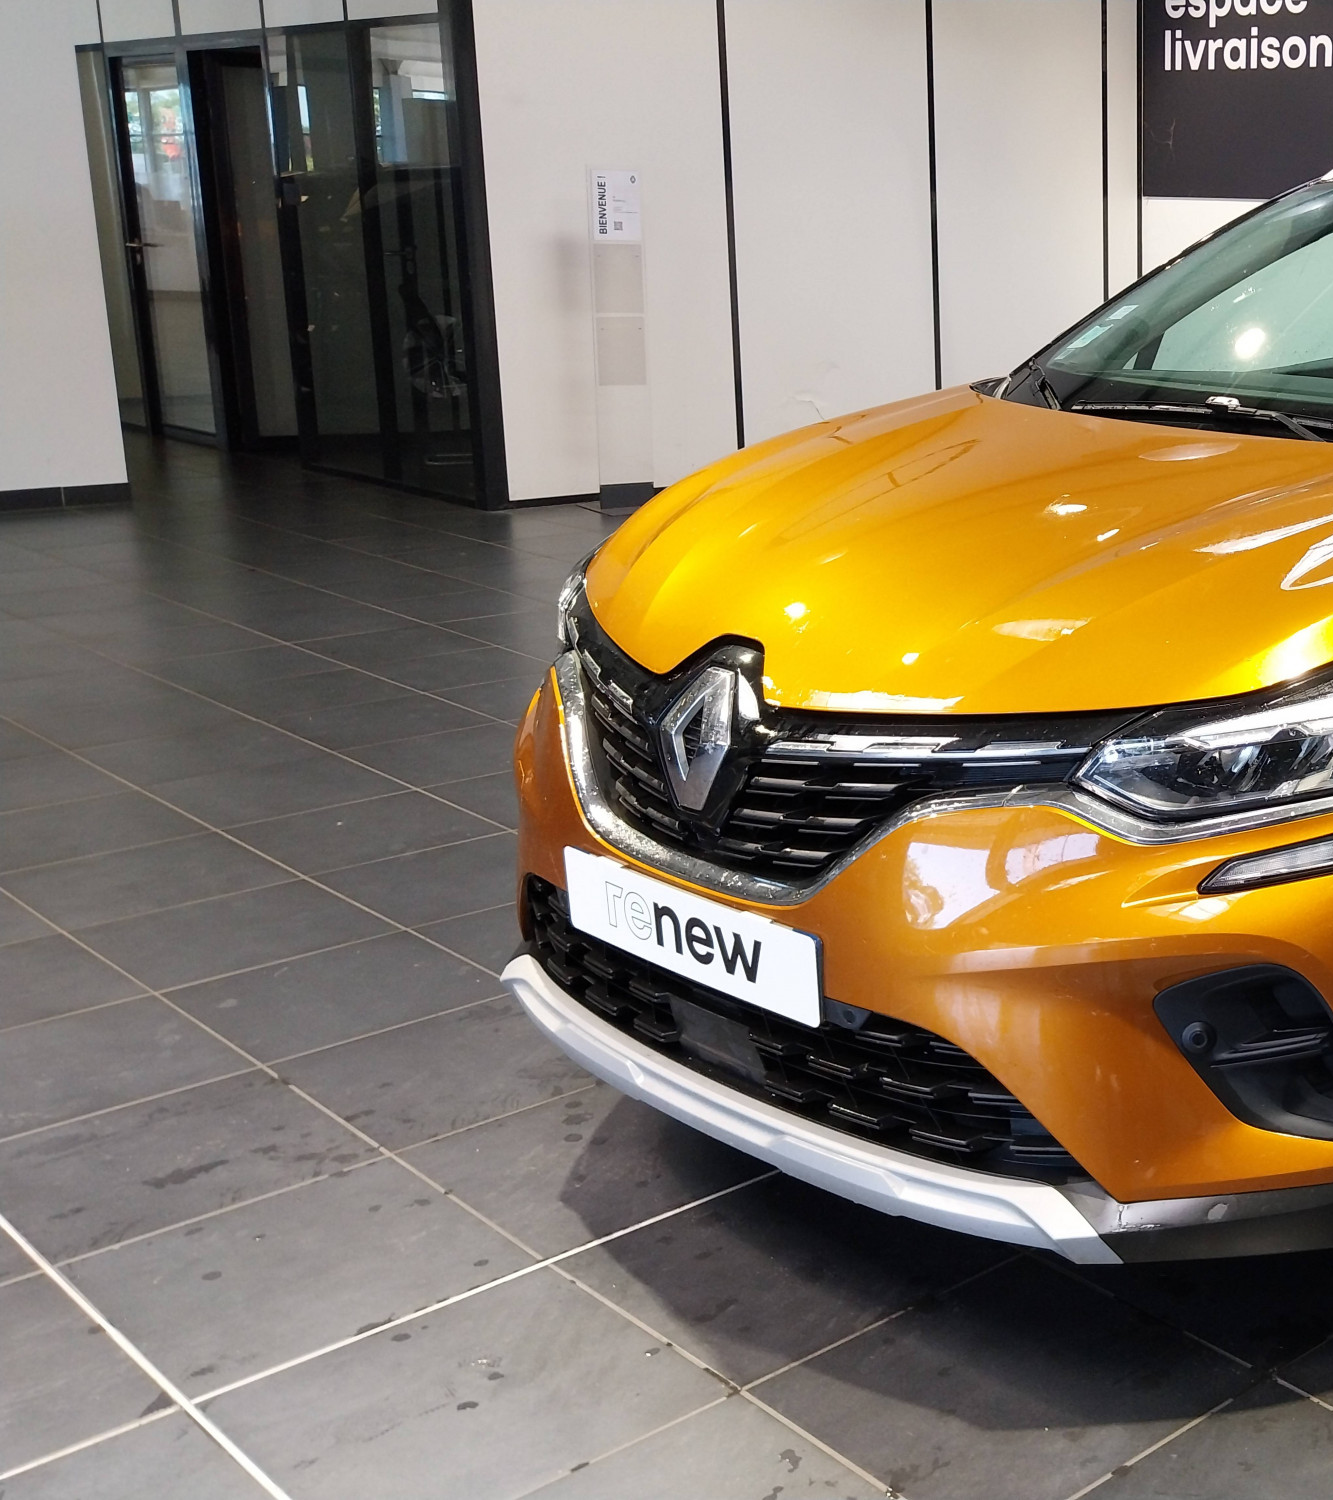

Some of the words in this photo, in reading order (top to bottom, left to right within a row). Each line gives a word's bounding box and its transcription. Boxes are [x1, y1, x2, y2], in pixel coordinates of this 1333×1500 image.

[1164, 26, 1333, 71] livraison
[597, 181, 608, 235] BIENVENUE
[605, 881, 762, 984] renew
